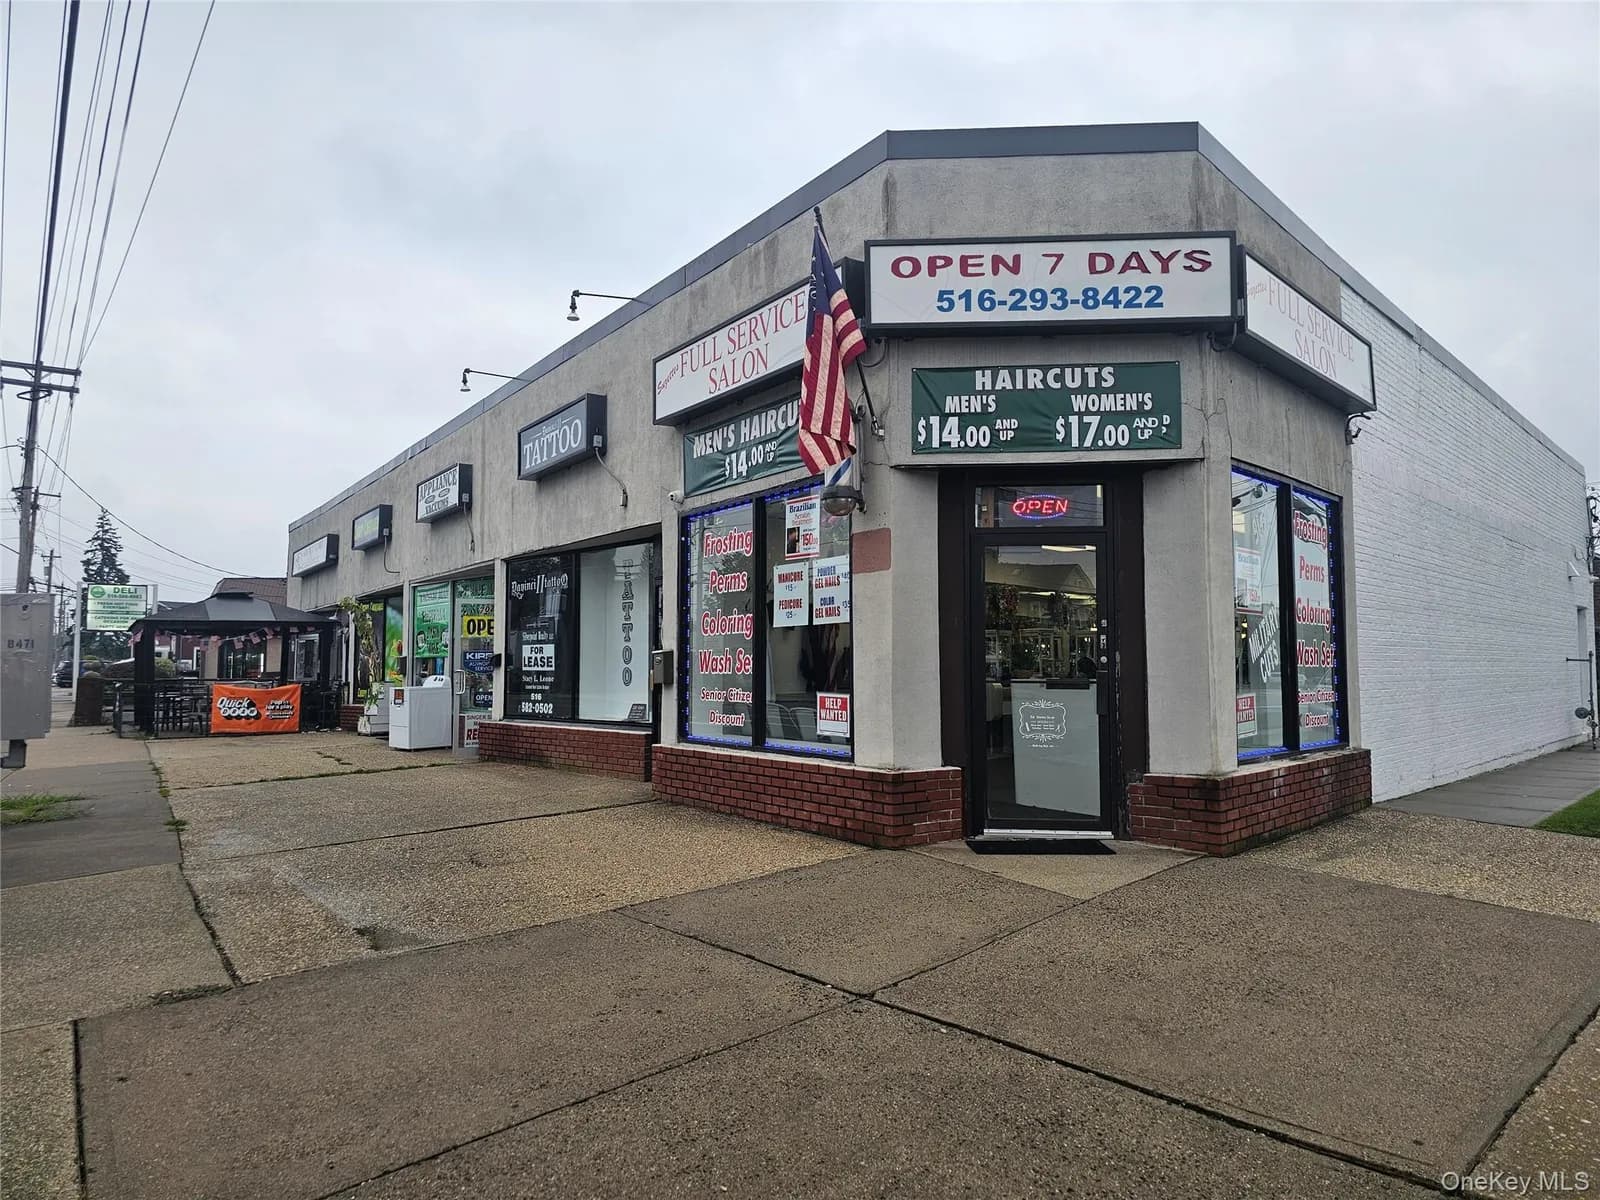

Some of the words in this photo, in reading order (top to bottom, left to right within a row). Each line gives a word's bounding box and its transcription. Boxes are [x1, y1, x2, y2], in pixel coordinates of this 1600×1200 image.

[890, 252, 1022, 278] OPEN
[1041, 252, 1065, 275] 7
[1087, 249, 1213, 275] DAYS
[935, 285, 1164, 313] 516-293-8422
[1268, 276, 1305, 327] FULL
[1307, 304, 1354, 362] SERVICE
[679, 336, 723, 379] FULL
[727, 291, 806, 355] SERVICE
[1294, 329, 1337, 378] SALON
[708, 342, 769, 395] SALON
[975, 366, 1115, 390] HAIRCUTS
[944, 394, 997, 414] MEN'S
[1070, 393, 1153, 412] WOMEN'S
[693, 426, 736, 459] MEN'S
[740, 400, 800, 444] HAIRCU
[917, 415, 991, 449] $14.00
[995, 419, 1019, 430] AND
[1055, 415, 1130, 448] $17.00
[1133, 417, 1159, 428] AND
[999, 430, 1015, 441] UP
[1137, 429, 1153, 440] UP
[523, 418, 582, 469] TATTOO
[725, 444, 764, 480] $14.00
[765, 439, 777, 452] AND
[767, 451, 775, 463] UP
[420, 468, 458, 502] APPLIANCE
[789, 502, 817, 513] Brazilian
[1012, 499, 1068, 514] OPEN
[1294, 510, 1328, 550] Frosting
[703, 526, 753, 558] Frosting
[777, 570, 804, 584] MANICURE
[1299, 555, 1325, 584] Perms
[708, 569, 748, 594] Perms
[814, 578, 824, 589] GEL
[824, 575, 841, 588] NAILS
[778, 598, 803, 610] PEDICURE
[815, 608, 824, 619] GEL
[825, 606, 841, 618] NAILS
[820, 596, 835, 607] COLOR
[701, 608, 754, 640] Coloring
[1296, 597, 1332, 632] Coloring
[466, 618, 494, 636] OPE
[1248, 606, 1279, 664] MILITARY
[530, 646, 544, 655] FOR
[699, 648, 733, 675] Wash
[735, 647, 753, 675] Se
[1260, 639, 1280, 683] CUTS
[1297, 639, 1320, 667] Wash
[1320, 641, 1335, 668] Set
[523, 656, 553, 668] LEASE
[217, 696, 250, 708] Quick
[700, 687, 726, 702] Senior
[825, 697, 842, 709] HELP
[1238, 698, 1251, 710] HELP
[1297, 689, 1317, 704] Senior
[1317, 689, 1335, 703] Citizen
[708, 710, 745, 727] Discount
[820, 708, 847, 721] WANTED
[1305, 712, 1329, 728] Discount
[466, 728, 479, 741] RE
